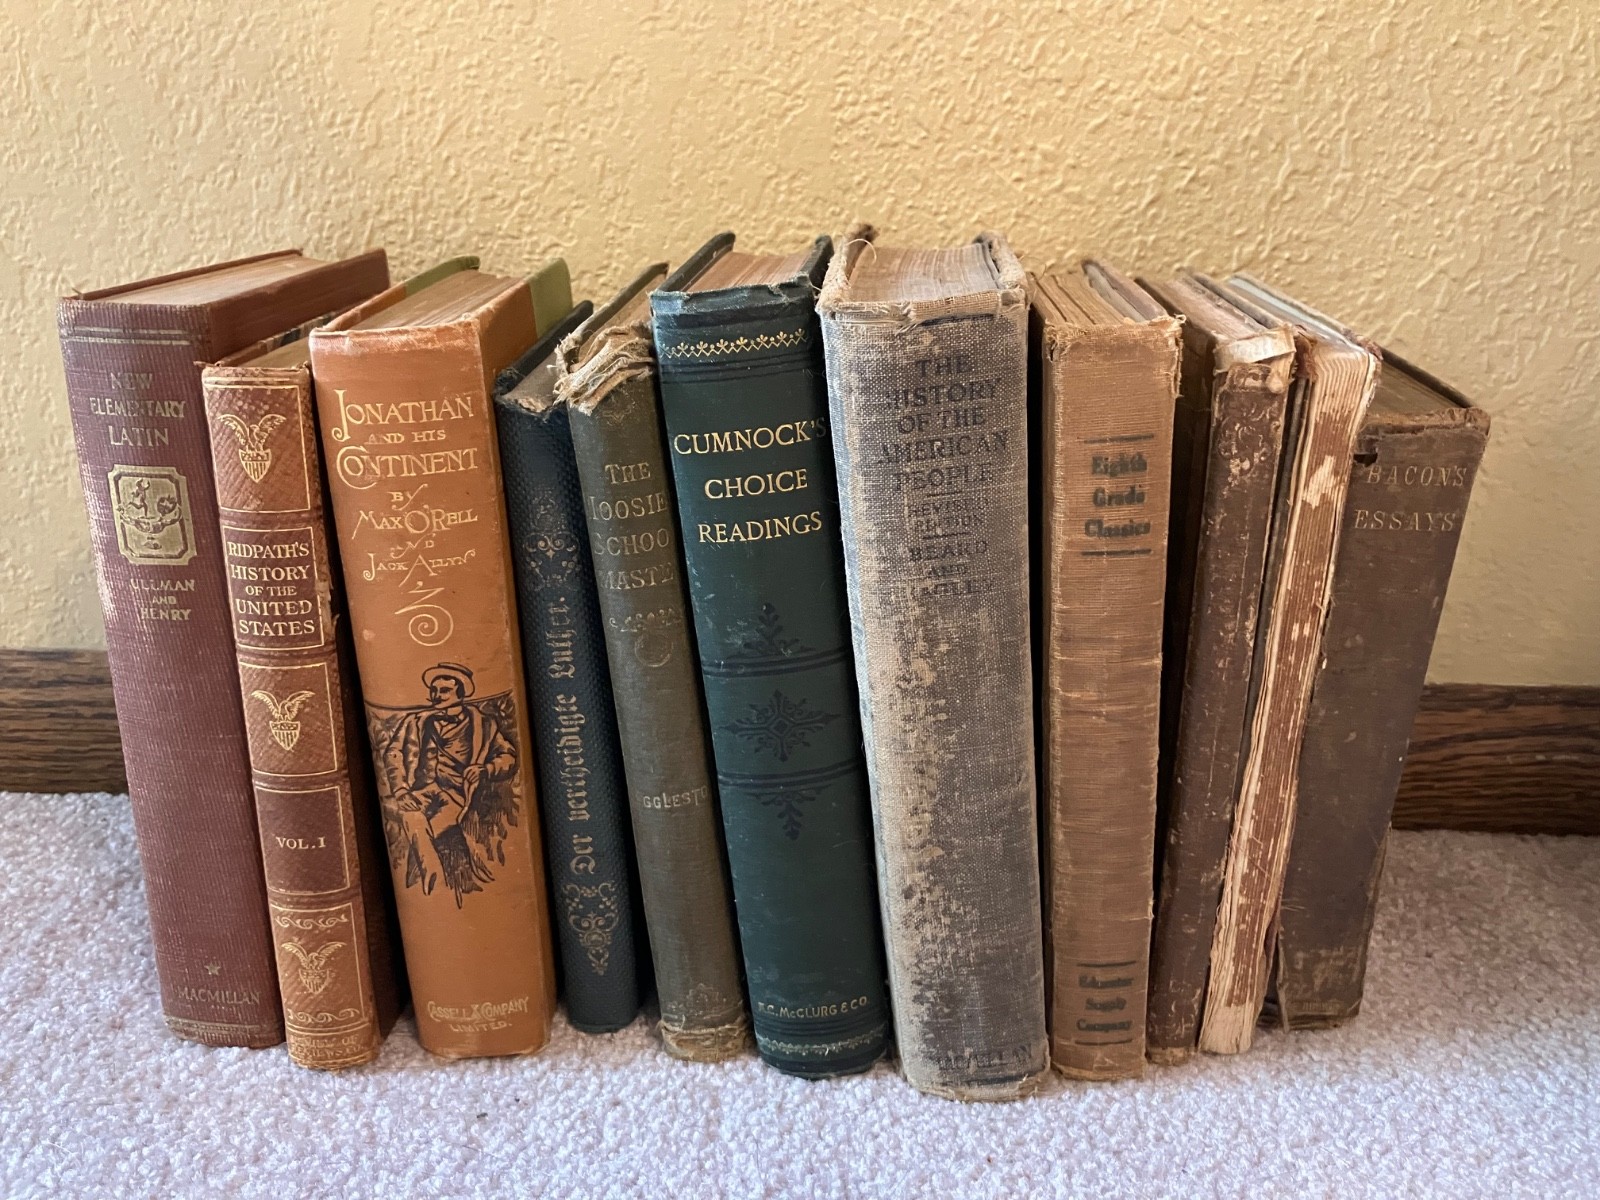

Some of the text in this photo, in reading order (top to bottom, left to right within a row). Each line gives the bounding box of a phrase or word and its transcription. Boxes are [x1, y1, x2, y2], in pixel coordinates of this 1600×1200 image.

[914, 355, 974, 377] THE
[111, 372, 153, 389] NEW
[884, 377, 1001, 411] HISTORY
[332, 389, 475, 442] JONATHAN
[897, 406, 987, 435] OF THE
[108, 425, 169, 446] LATIN
[364, 429, 447, 444] AND HIS
[674, 417, 827, 455] CUMNOCK'S
[878, 430, 1008, 465] AMERICAN
[337, 445, 478, 490] CONTINENT
[604, 462, 651, 485] THE
[892, 463, 993, 491] PEOPLE
[1367, 464, 1467, 486] BACON'S
[704, 468, 808, 499] CHOICE
[387, 484, 428, 511] BY
[588, 492, 668, 521] OOSIE
[698, 511, 822, 543] READINGS
[1354, 509, 1456, 532] ESSAYS
[227, 541, 310, 559] RIDPATH'S
[593, 528, 670, 556] SCHOO
[909, 539, 988, 562] BEARD
[230, 564, 311, 582] HISTORY
[363, 553, 408, 581] JACK
[153, 596, 177, 605] AND
[245, 586, 298, 597] OF THE
[140, 608, 192, 620] HENRY
[235, 598, 313, 617] UNITED
[238, 619, 315, 638] STATES
[643, 785, 708, 809] GGLESTO
[177, 986, 261, 1005] MACMILLAN
